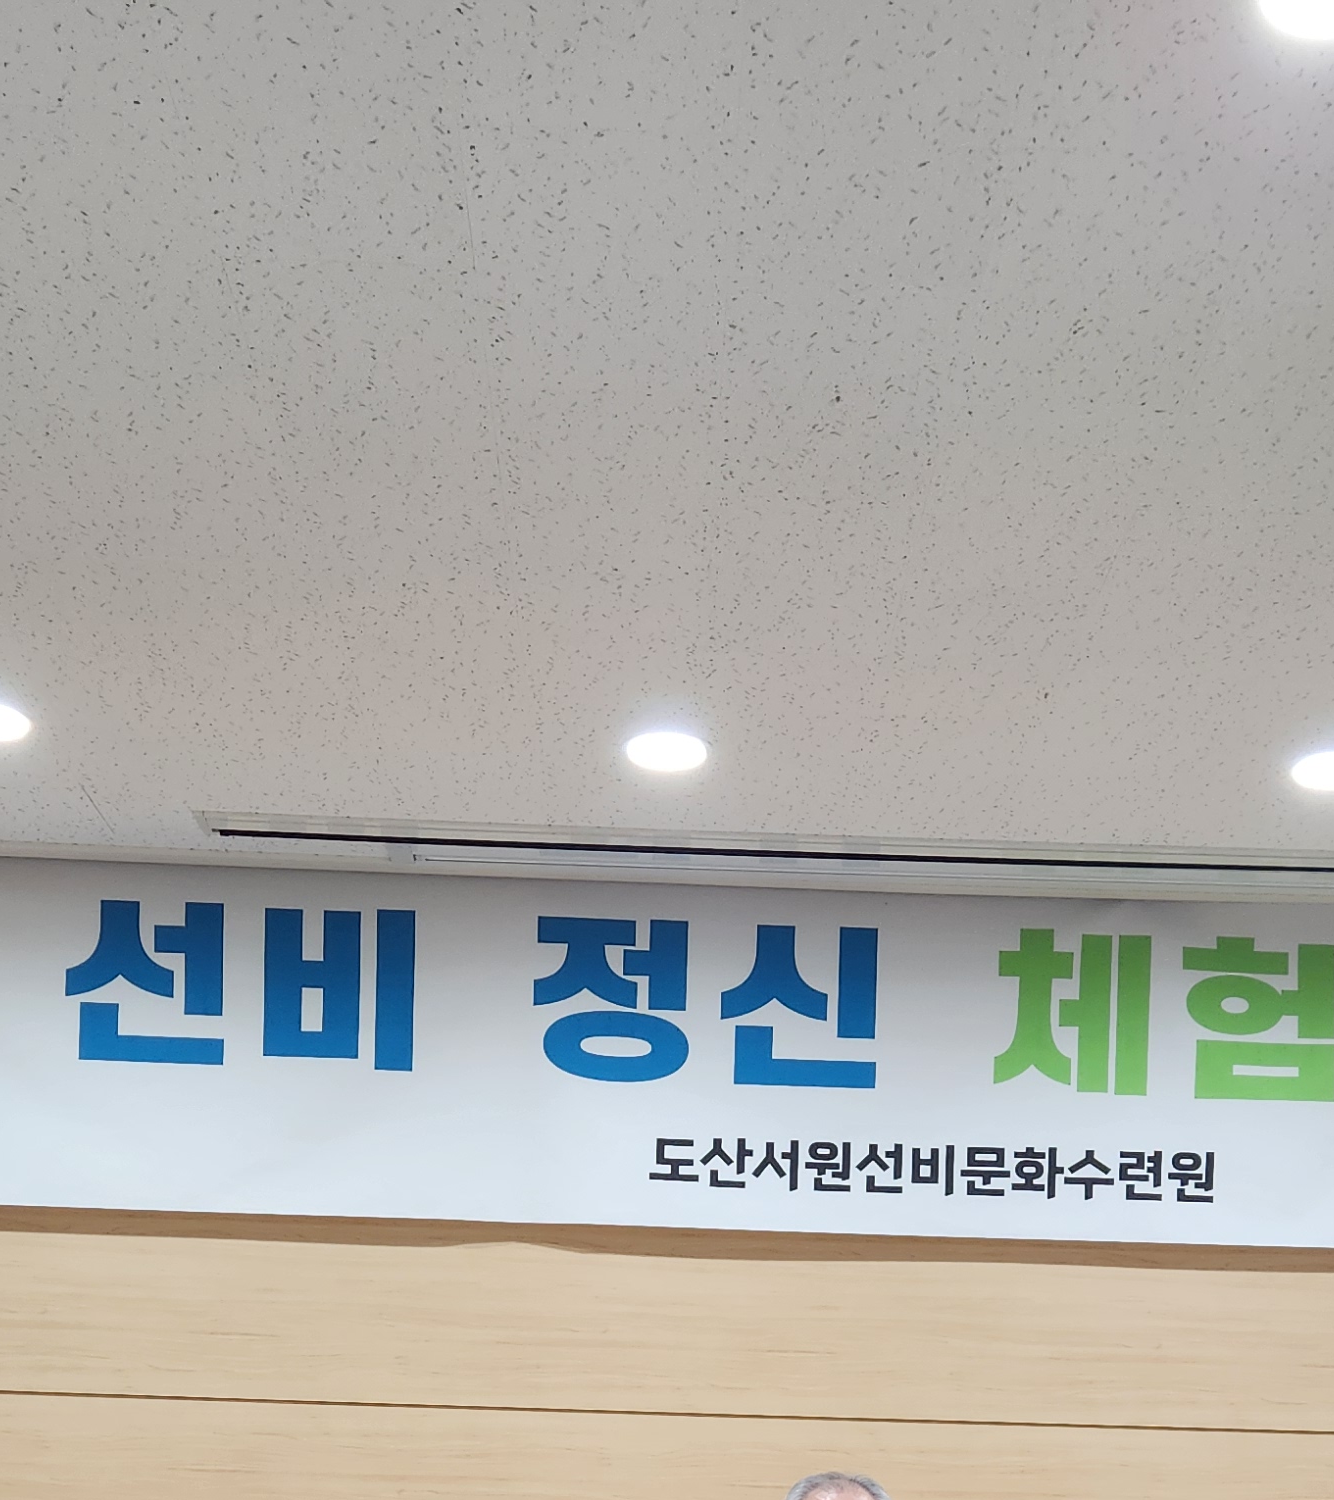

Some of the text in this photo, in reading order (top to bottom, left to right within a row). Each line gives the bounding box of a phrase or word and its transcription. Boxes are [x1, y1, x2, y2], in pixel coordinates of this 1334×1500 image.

[66, 900, 415, 1072] 선비
[534, 916, 878, 1089] 정신
[649, 1138, 1215, 1203] 도산서원선비문화수련원
